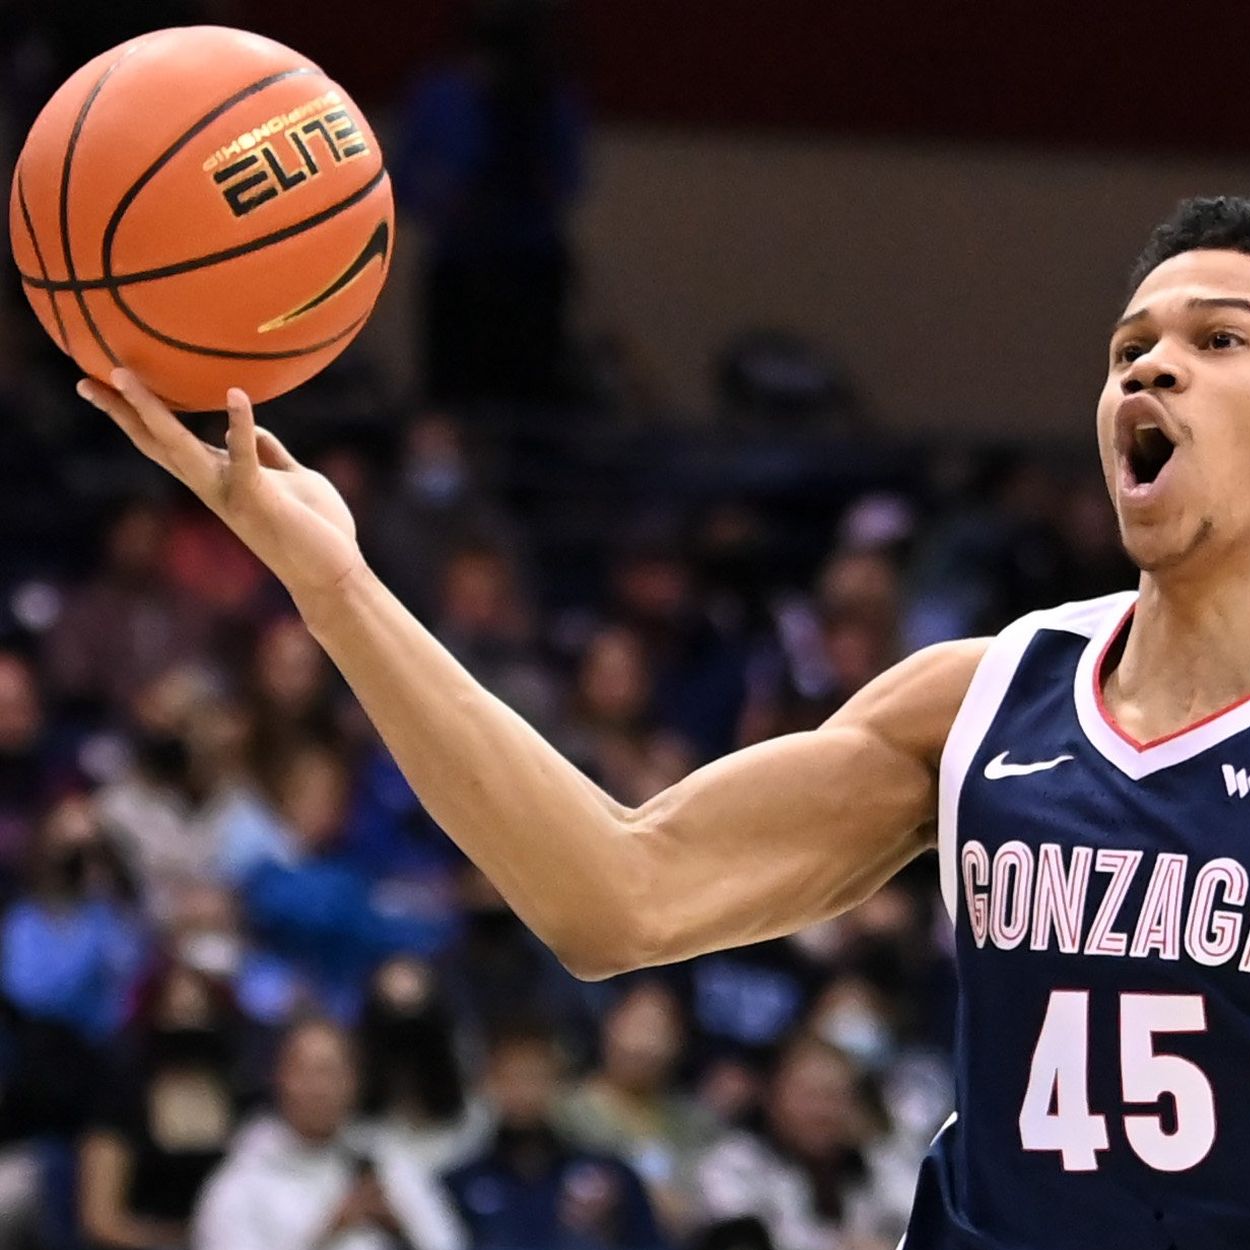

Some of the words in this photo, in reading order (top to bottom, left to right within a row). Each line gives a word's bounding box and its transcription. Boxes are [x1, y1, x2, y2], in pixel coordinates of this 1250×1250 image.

[202, 91, 342, 172] PIONSHIP
[211, 105, 370, 218] ELITE
[1018, 990, 1217, 1172] 45
